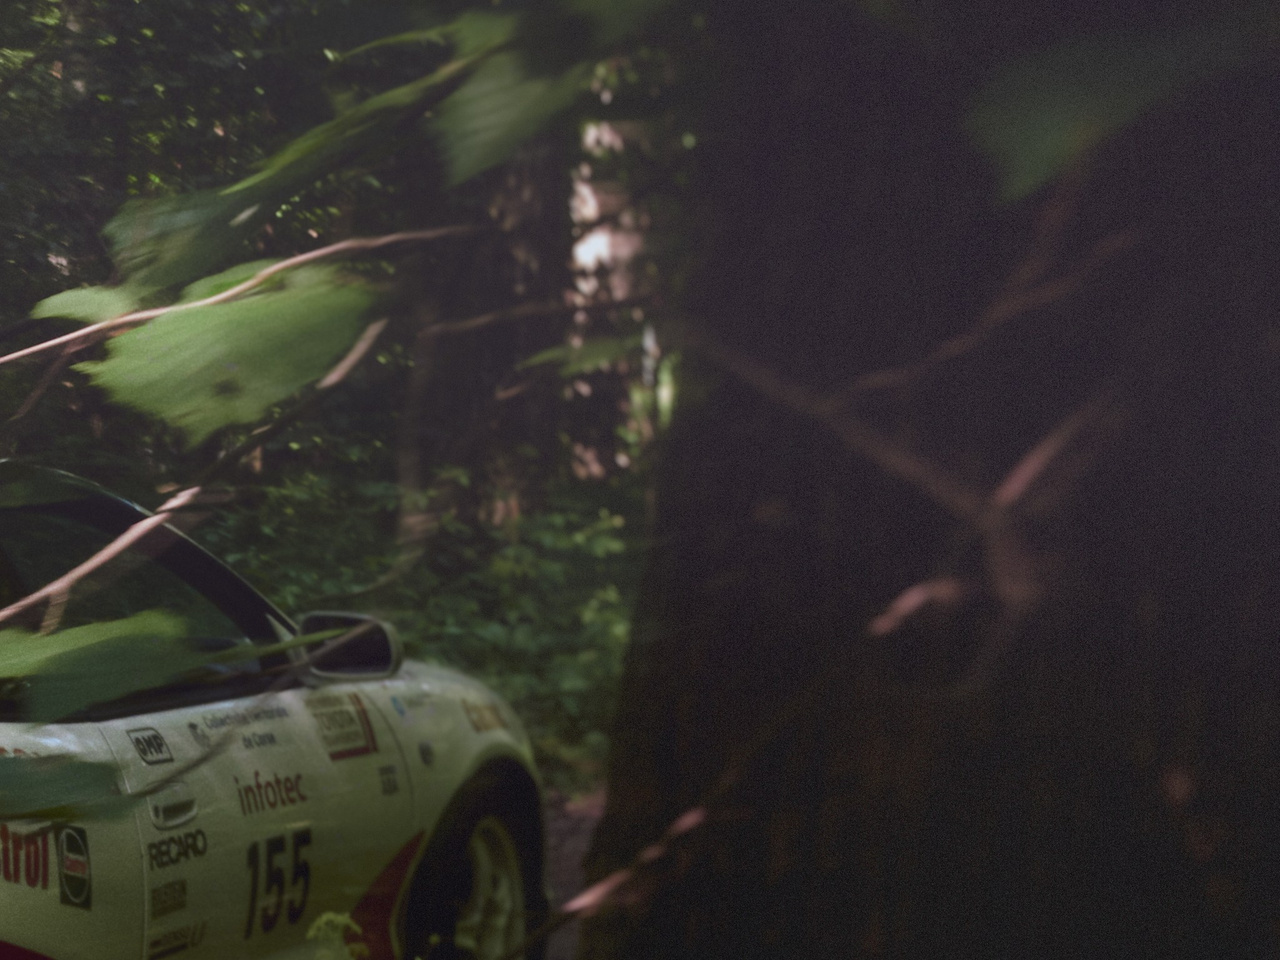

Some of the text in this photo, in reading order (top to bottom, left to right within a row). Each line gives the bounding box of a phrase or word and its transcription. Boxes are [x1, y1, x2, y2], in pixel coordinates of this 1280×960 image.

[134, 734, 164, 757] OMP
[234, 771, 307, 816] infotec
[148, 829, 207, 872] RECARO
[244, 828, 313, 939] 155
